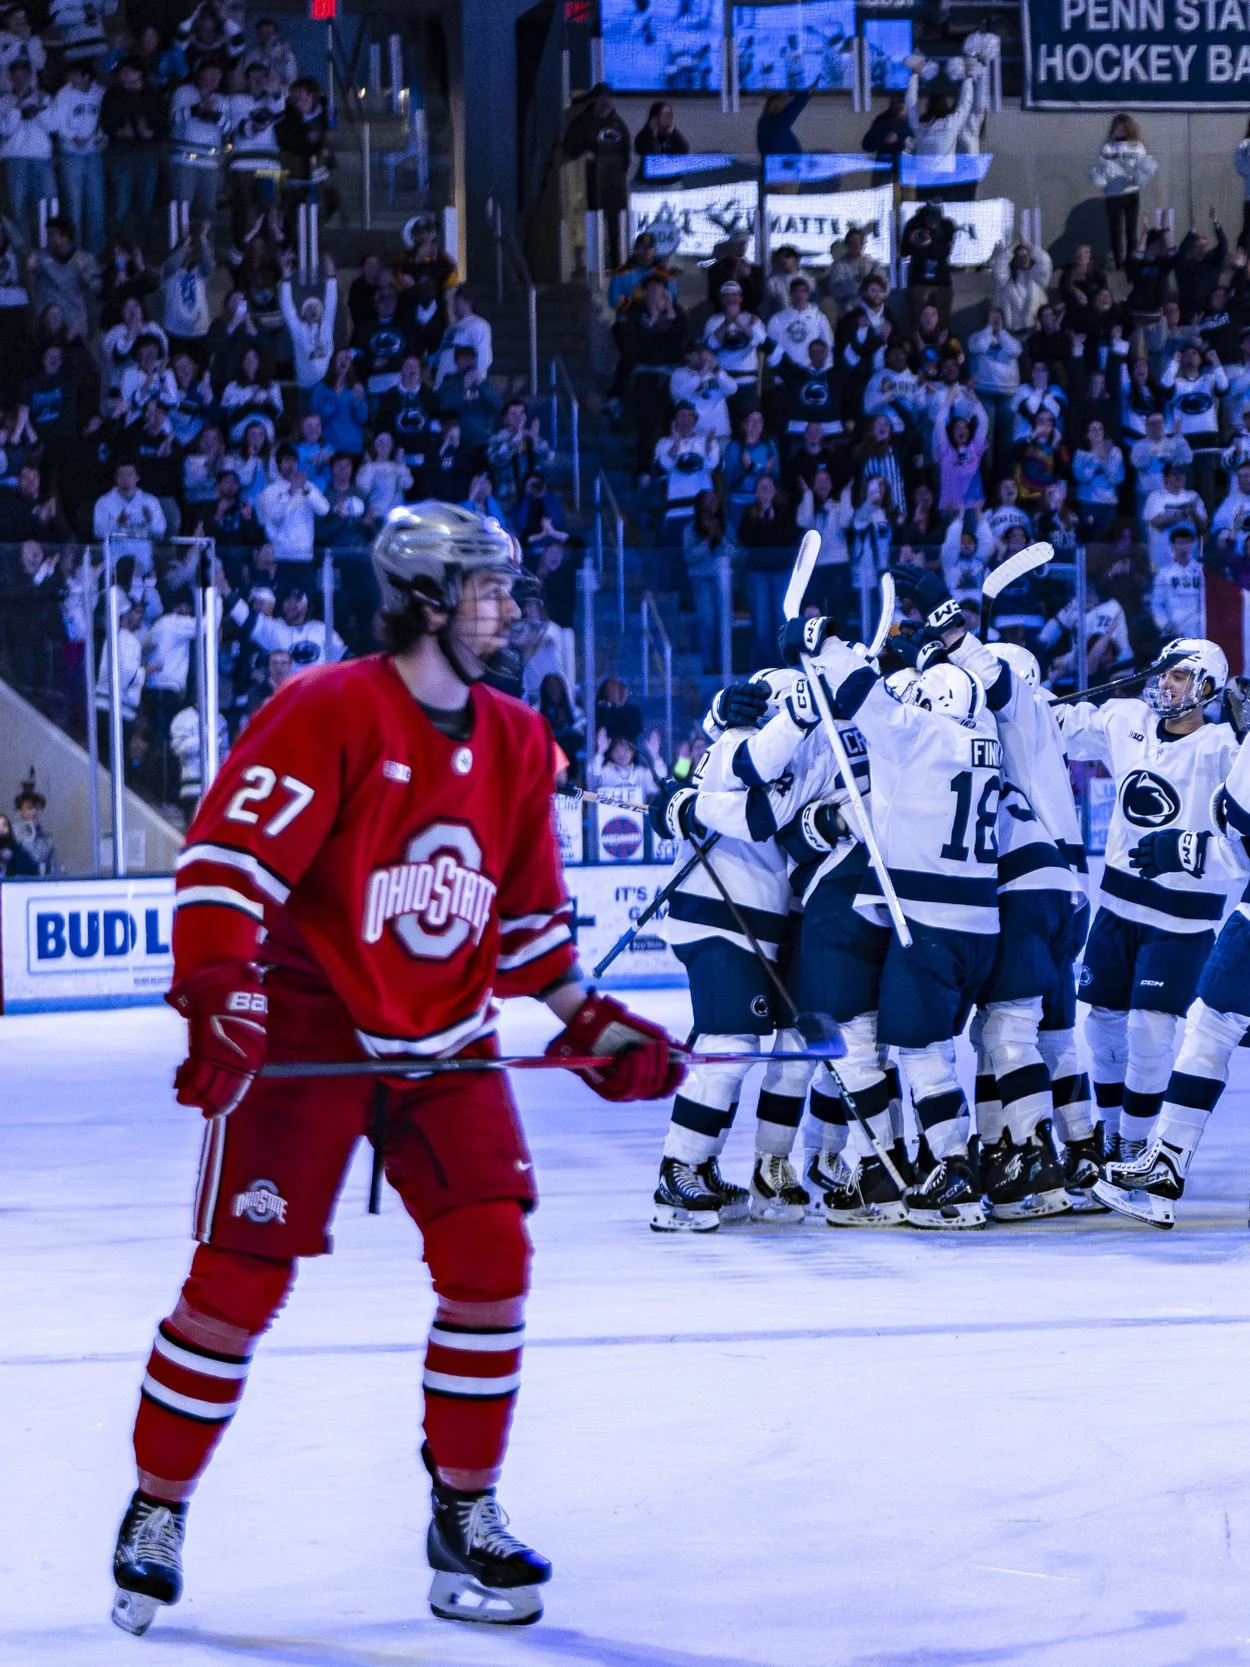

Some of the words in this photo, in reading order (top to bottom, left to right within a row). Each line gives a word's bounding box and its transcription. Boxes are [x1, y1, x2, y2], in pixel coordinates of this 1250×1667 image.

[1060, 0, 1166, 31] PENN
[1038, 43, 1199, 83] HOCKEY
[224, 764, 315, 837] 27
[615, 886, 647, 901] IT'S
[36, 911, 138, 960] BUD
